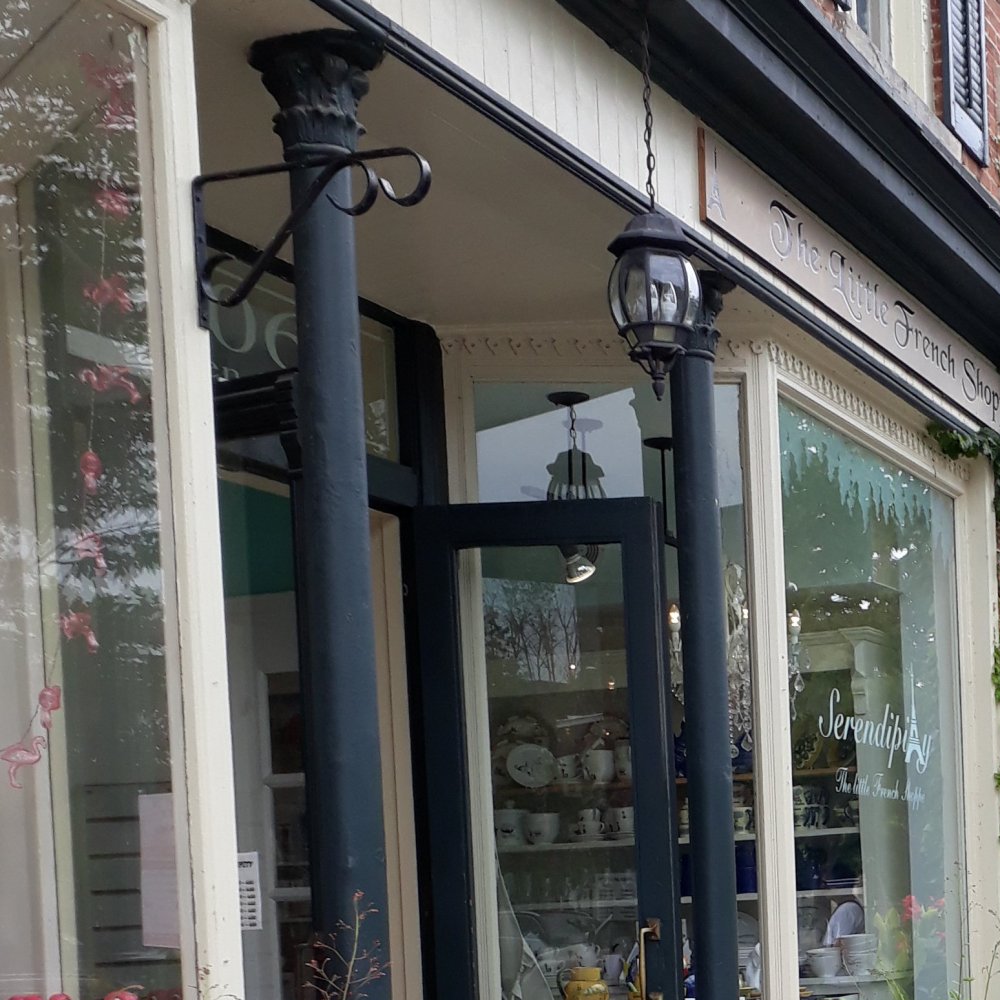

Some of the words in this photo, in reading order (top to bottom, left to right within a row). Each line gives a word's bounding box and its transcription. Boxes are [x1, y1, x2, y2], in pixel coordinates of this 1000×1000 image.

[769, 200, 820, 274] The
[829, 250, 889, 326] Little
[893, 300, 956, 380] French
[835, 767, 851, 793] The
[872, 773, 899, 800] French
